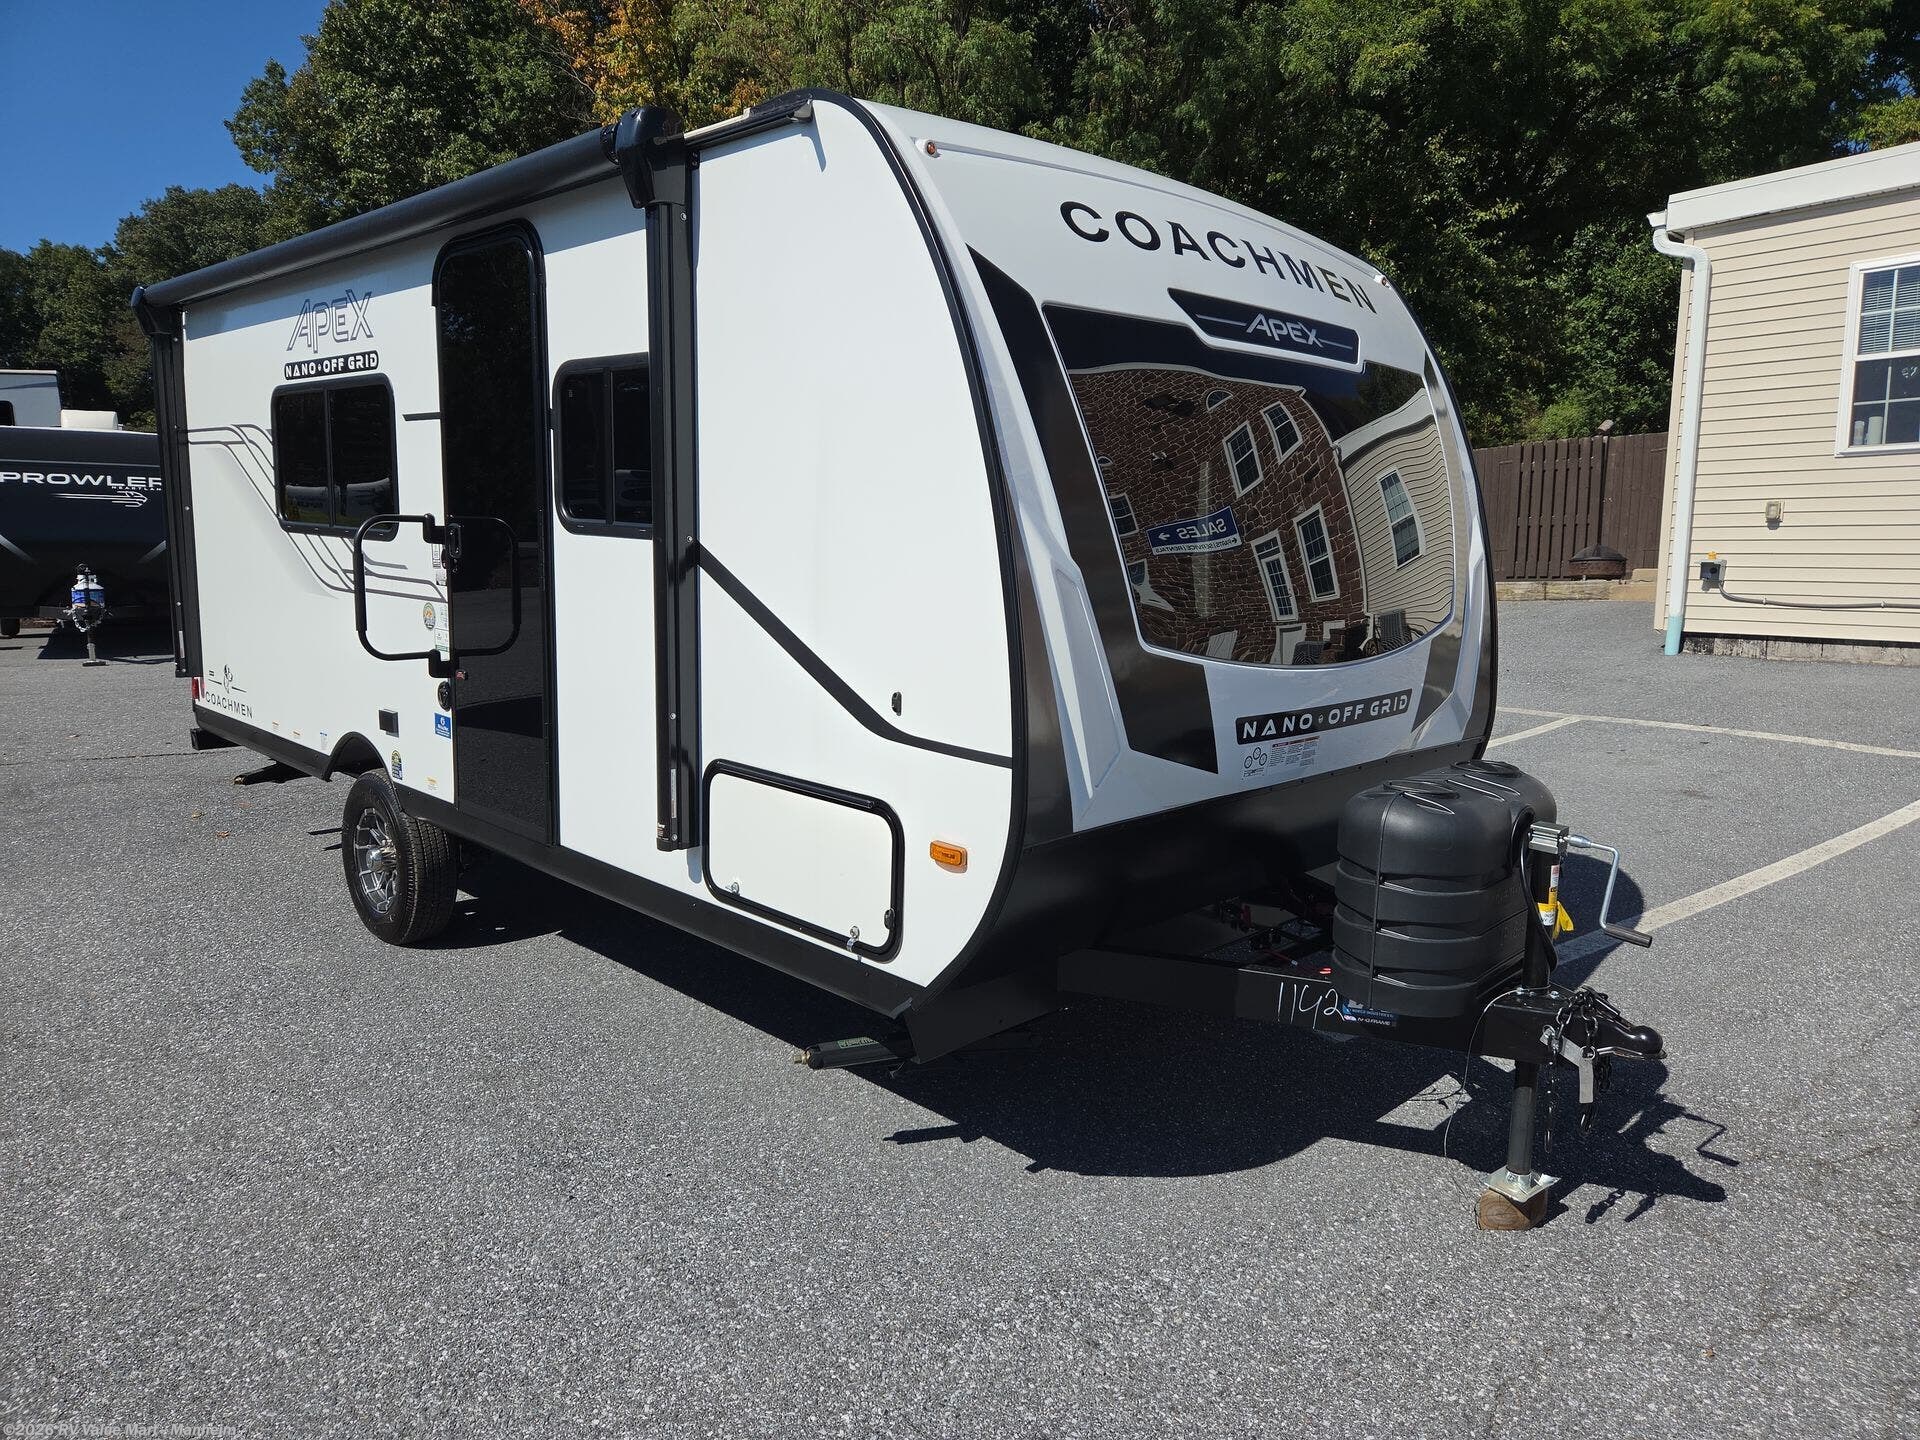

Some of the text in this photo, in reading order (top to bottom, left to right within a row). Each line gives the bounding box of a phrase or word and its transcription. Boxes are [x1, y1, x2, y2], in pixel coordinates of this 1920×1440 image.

[1060, 201, 1377, 314] COACHMEN
[286, 288, 374, 354] APEX
[1246, 313, 1324, 348] APEX
[285, 353, 378, 378] NANO OFF GRID
[205, 691, 253, 719] COACHMEN
[1242, 694, 1408, 739] NANO OFF GRID
